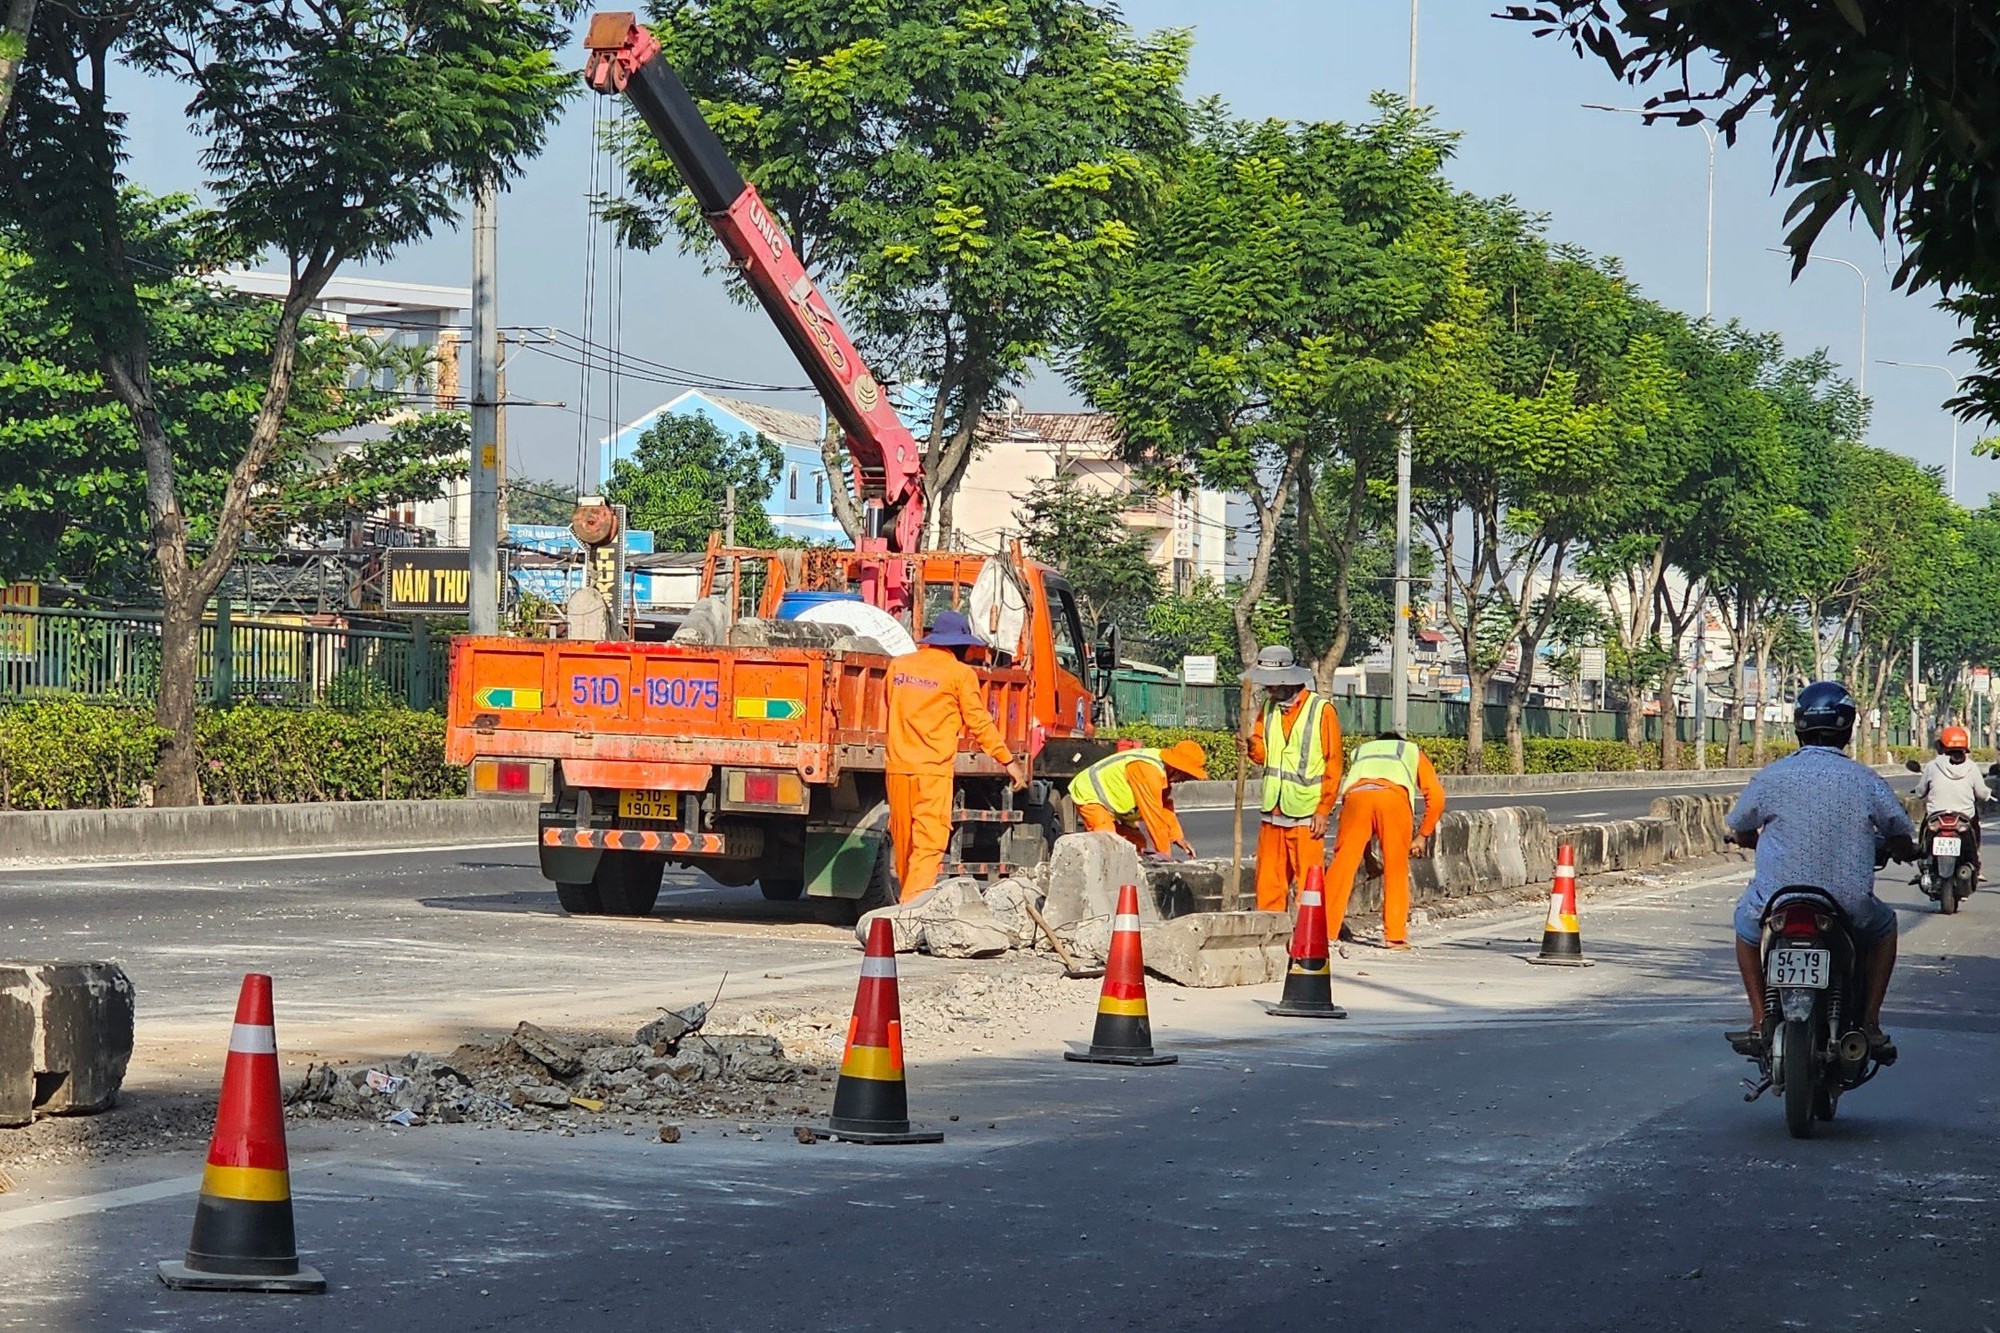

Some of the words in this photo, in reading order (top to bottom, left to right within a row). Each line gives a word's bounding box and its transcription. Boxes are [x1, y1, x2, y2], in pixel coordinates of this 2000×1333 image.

[749, 199, 784, 260] UNIC
[391, 563, 430, 604] NĂM
[572, 675, 620, 705] 51D
[636, 790, 661, 802] 51D
[626, 802, 671, 817] 190.75
[1778, 952, 1820, 967] 54-Y9
[1777, 968, 1819, 984] 9715
